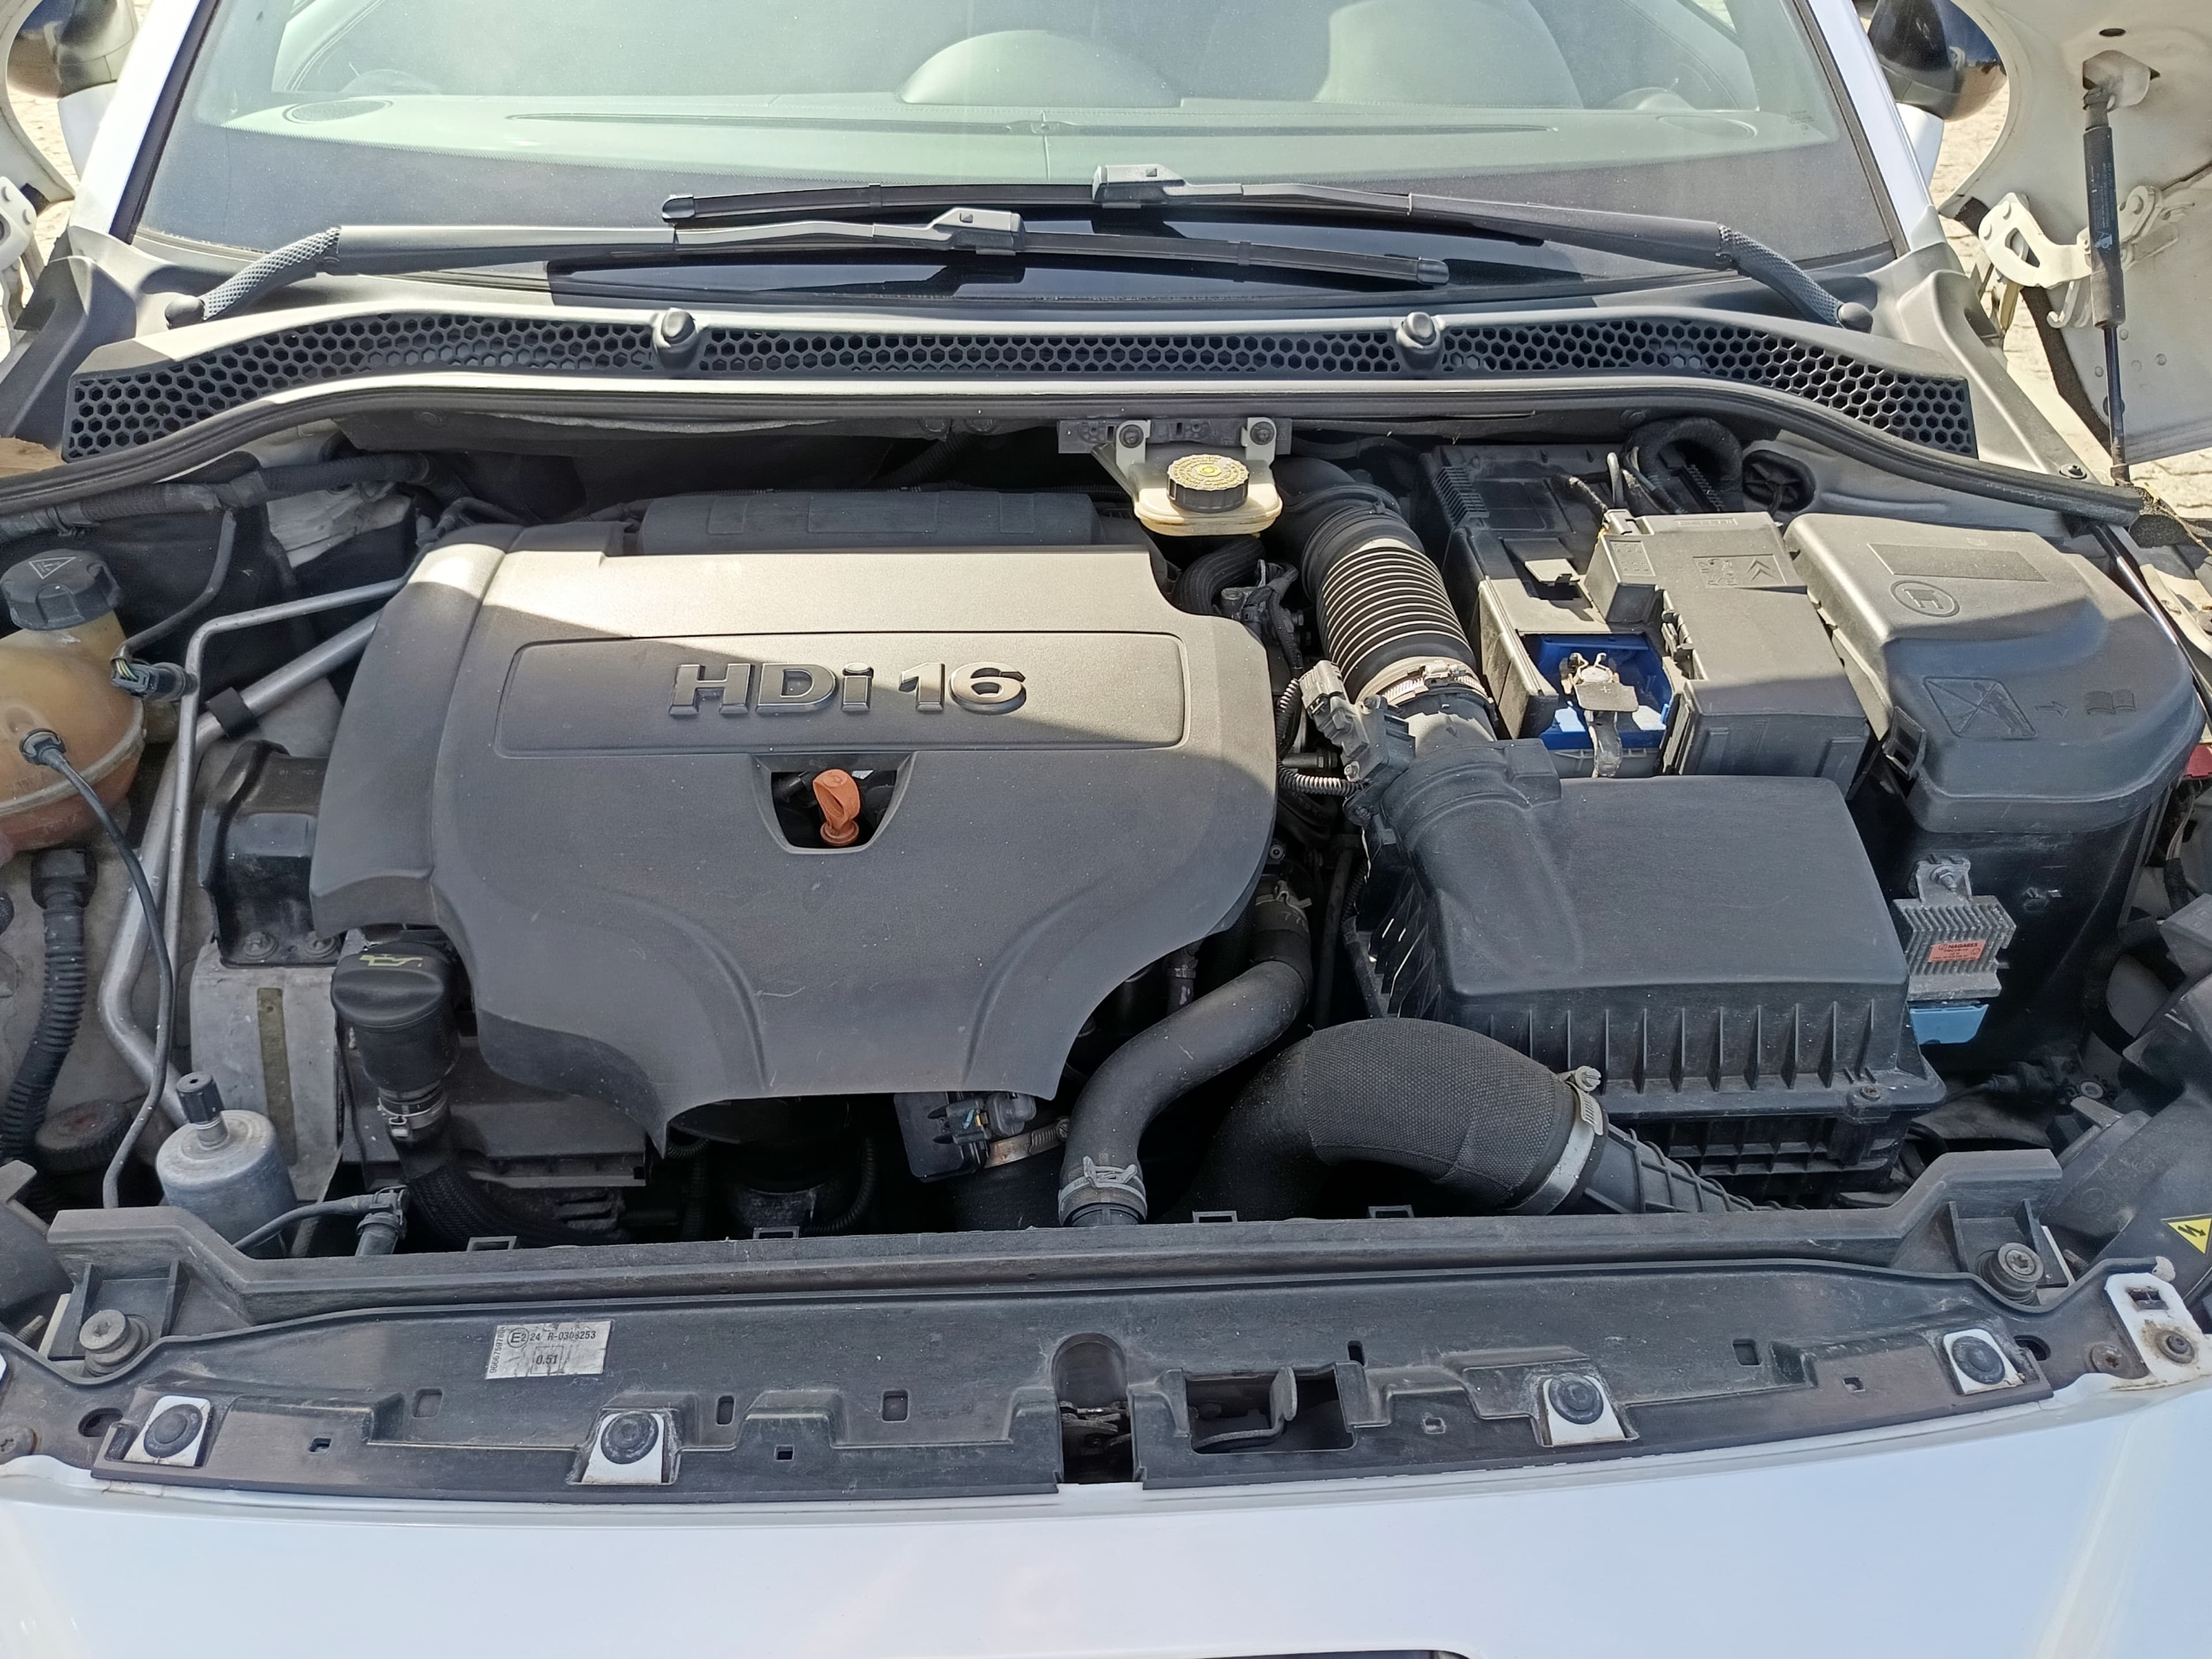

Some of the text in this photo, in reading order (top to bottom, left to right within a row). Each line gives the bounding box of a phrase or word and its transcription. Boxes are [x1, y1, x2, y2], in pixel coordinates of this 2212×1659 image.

[669, 662, 1027, 715] HDi 16
[530, 1332, 541, 1341] 24
[536, 1354, 558, 1365] 0.51
